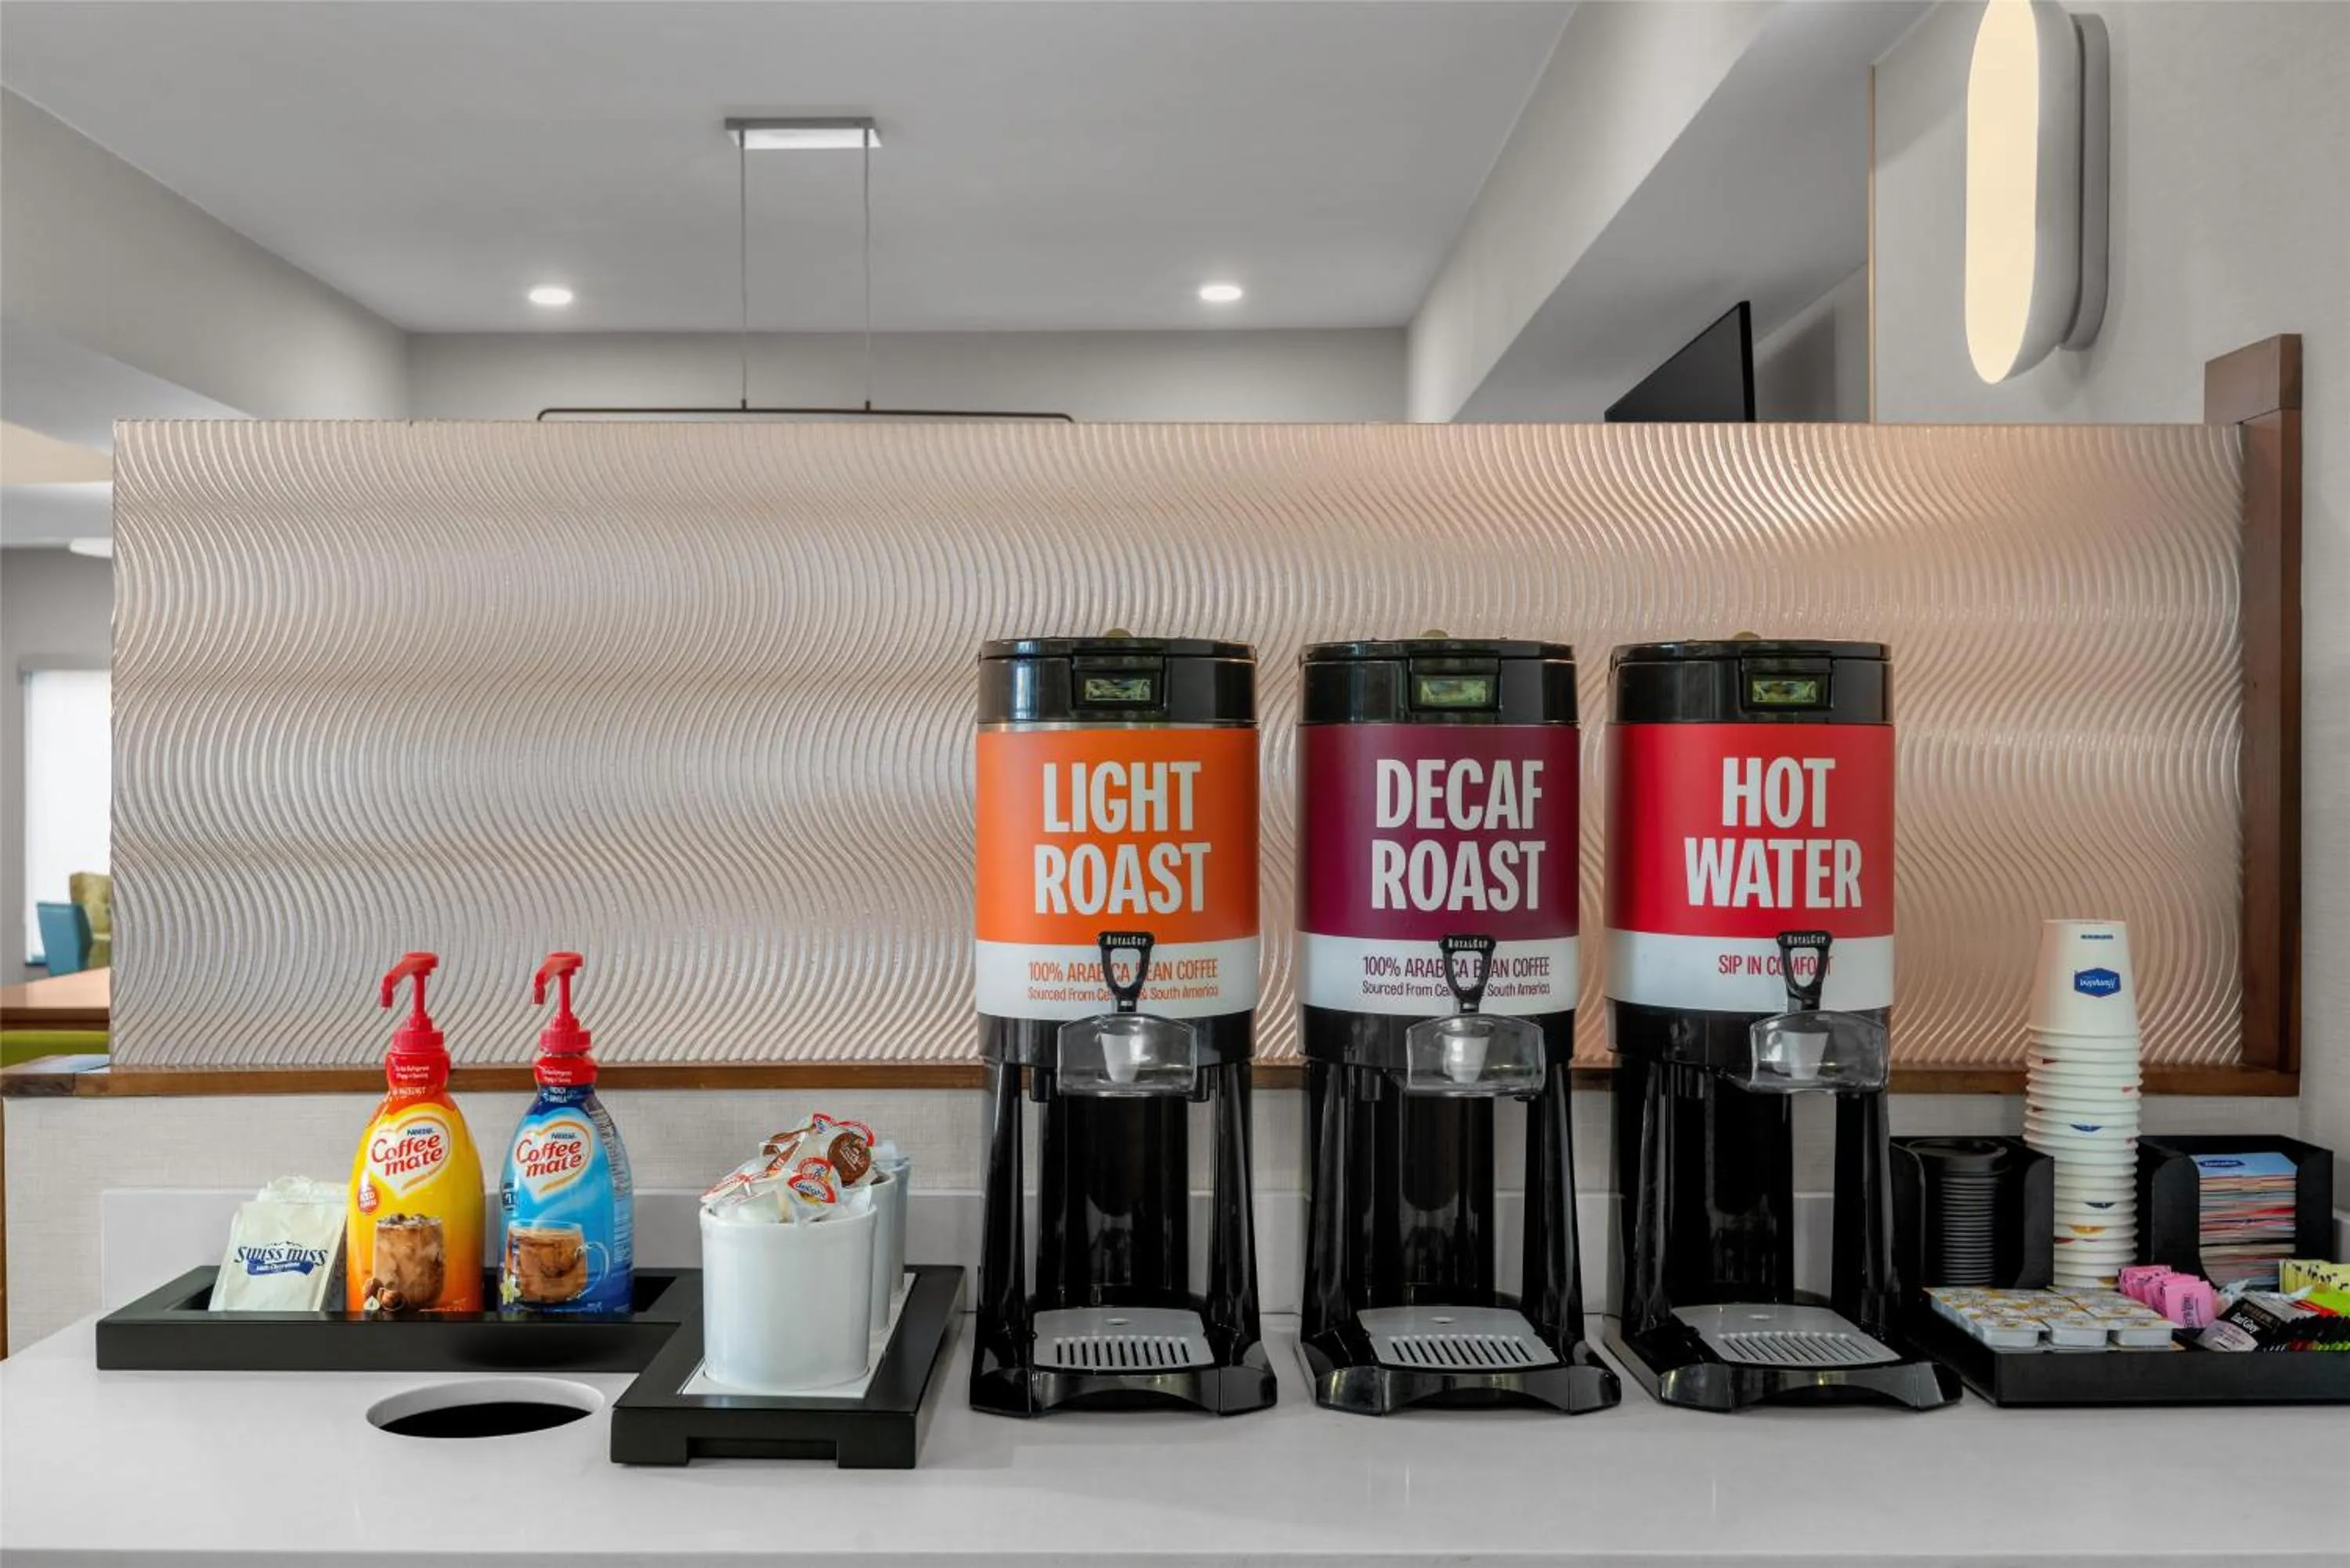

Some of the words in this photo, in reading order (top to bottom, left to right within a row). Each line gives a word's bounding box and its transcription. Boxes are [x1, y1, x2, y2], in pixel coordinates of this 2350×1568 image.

[1043, 761, 1202, 833] LIGHT
[1376, 758, 1543, 830] DECAF
[1722, 757, 1835, 828] HOT
[1034, 842, 1211, 916] ROAST
[1372, 839, 1546, 912] ROAST
[1684, 837, 1862, 908] WATER
[1028, 961, 1063, 981] 100%
[1067, 962, 1130, 982] ARABCA
[1135, 961, 1173, 981] EAN
[1177, 959, 1219, 979] COFFEE
[1363, 956, 1401, 977] 100%
[1405, 958, 1469, 978] ARABCA
[1473, 957, 1509, 977] BAN
[1513, 956, 1550, 976] COFFEE
[1718, 955, 1742, 974] SIP
[1748, 955, 1762, 975] IN
[1766, 955, 1832, 976] COMFOT
[1028, 987, 1066, 1001] Sourced
[1069, 988, 1093, 1001] From
[1150, 987, 1180, 1000] South
[1183, 985, 1219, 999] America
[1362, 980, 1403, 995] Sourced
[1406, 983, 1433, 997] From
[1488, 982, 1514, 997] South
[1517, 981, 1550, 995] America
[372, 1134, 440, 1162] Coffee
[516, 1140, 581, 1163] Coffee
[385, 1147, 443, 1176] mate
[526, 1154, 581, 1177] mate
